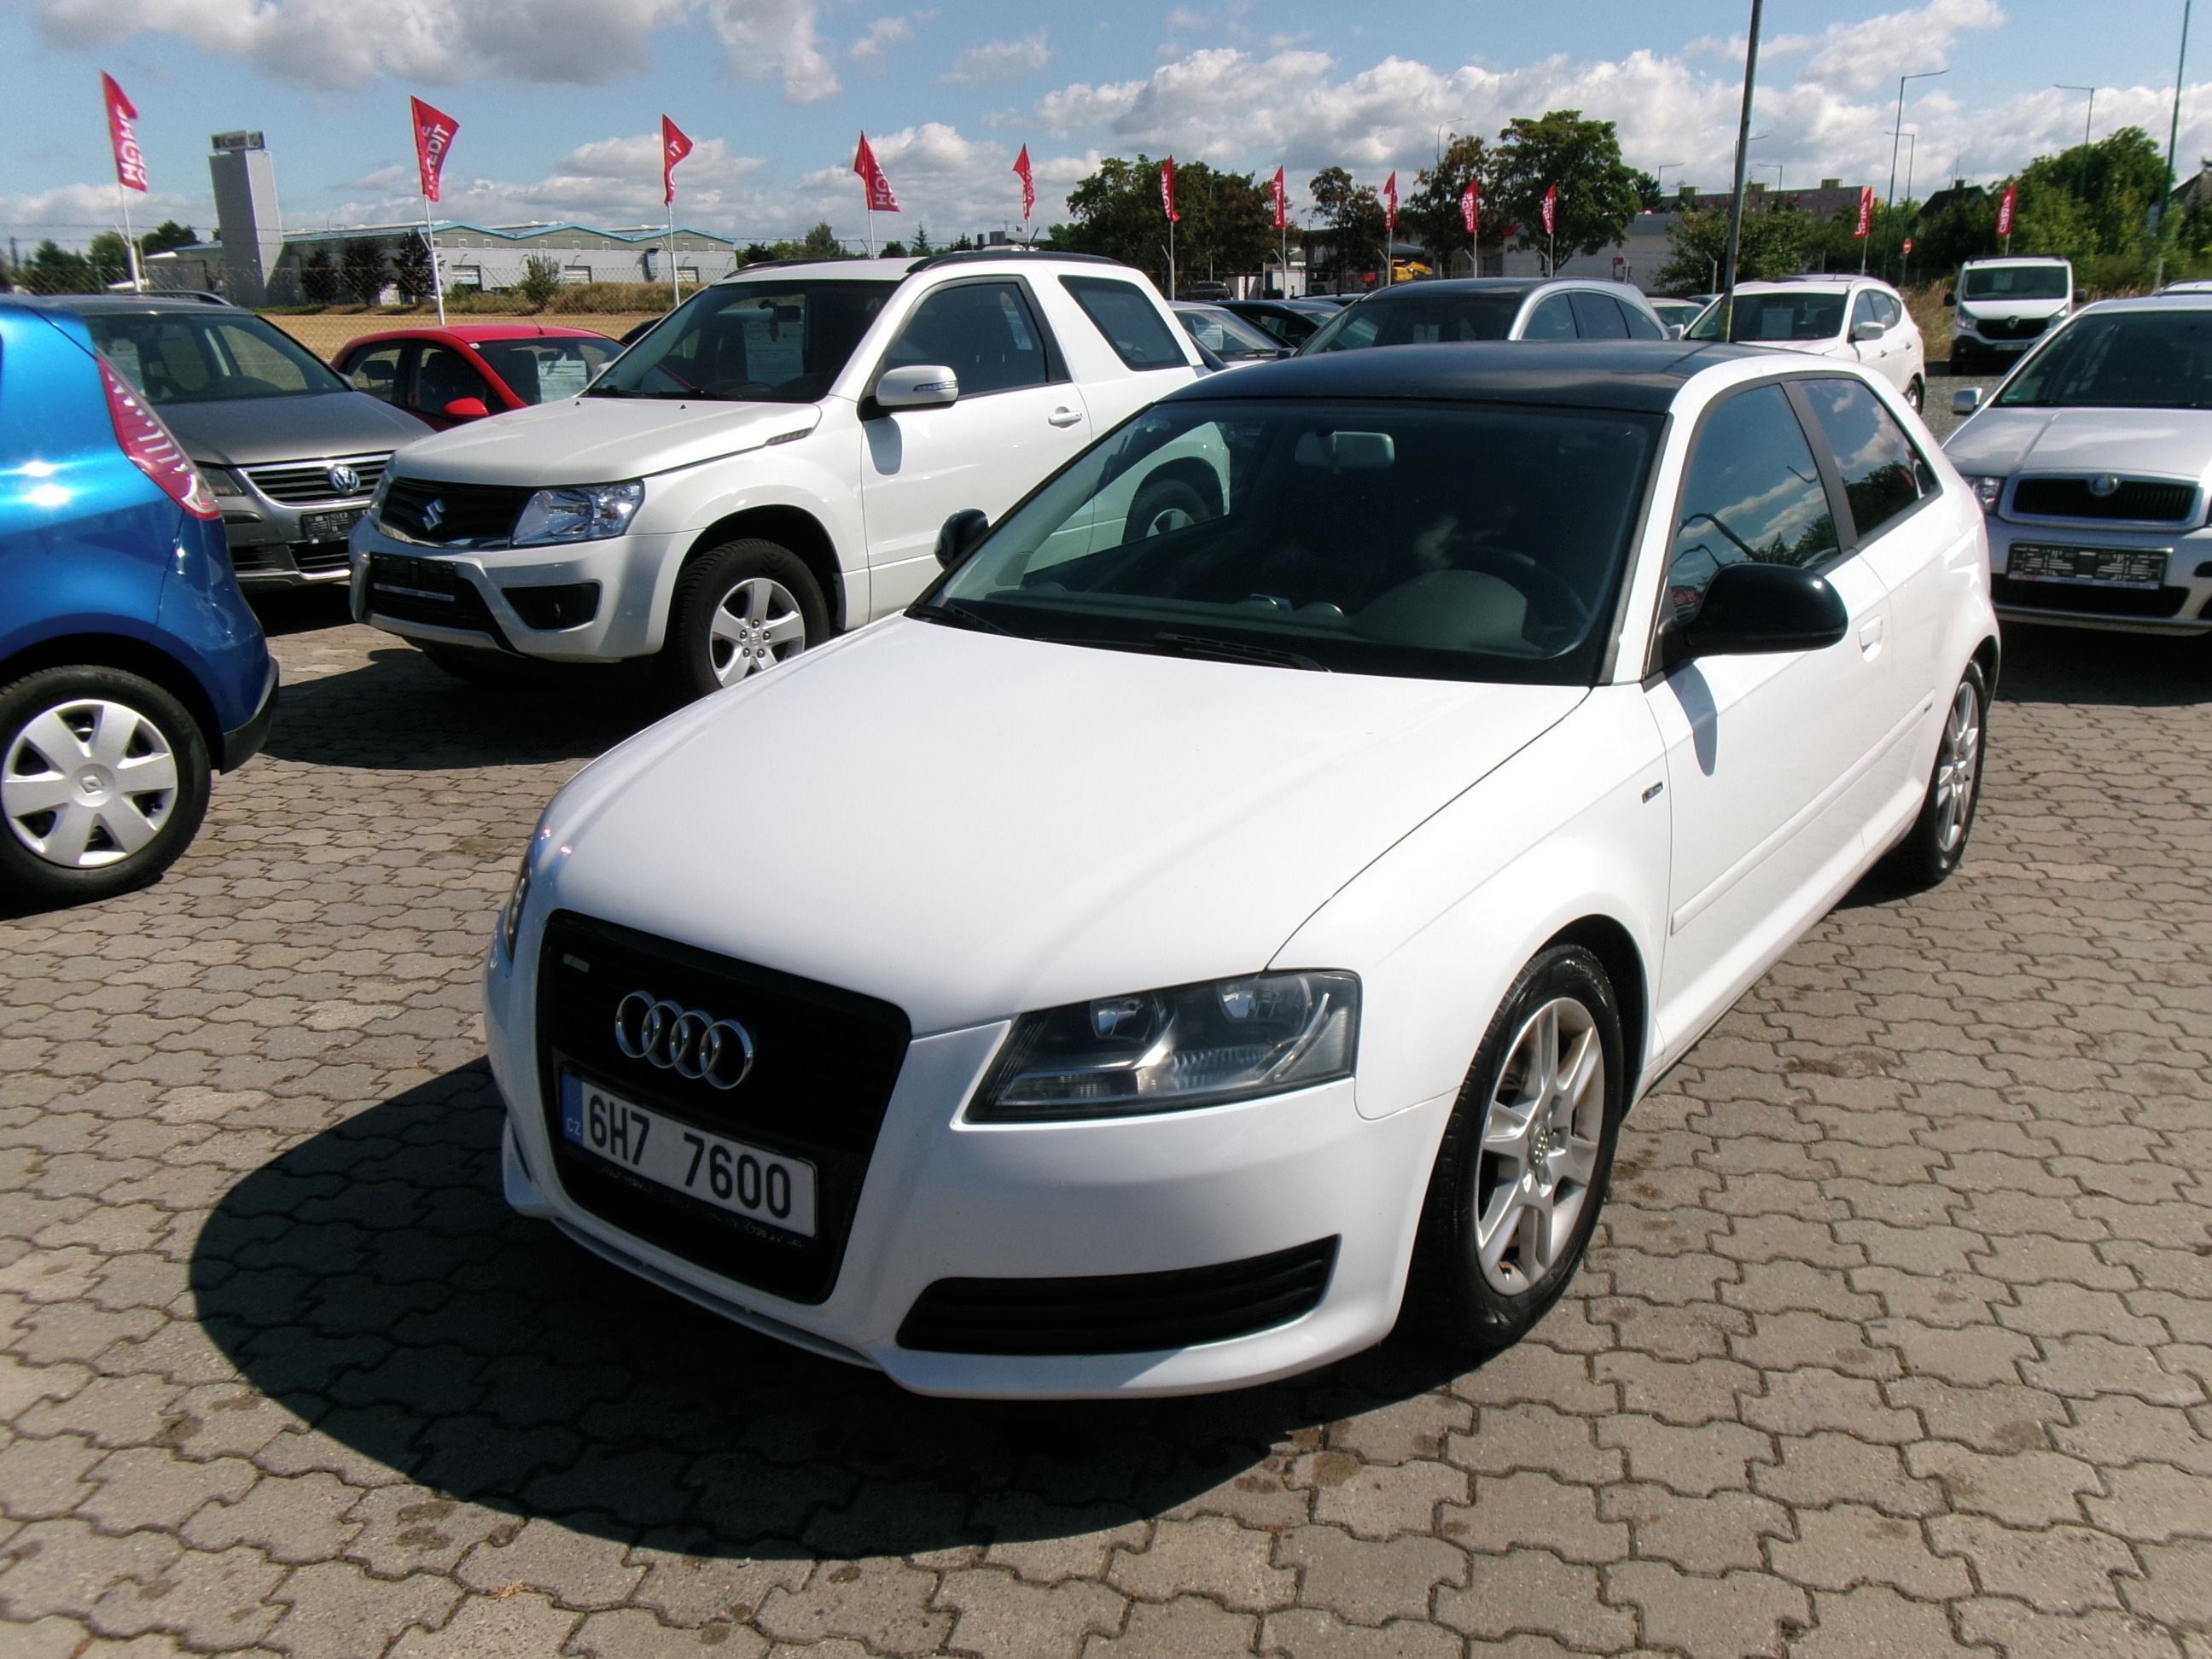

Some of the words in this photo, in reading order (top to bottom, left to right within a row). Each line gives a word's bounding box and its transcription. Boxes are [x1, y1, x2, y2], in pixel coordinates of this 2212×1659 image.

[566, 1117, 582, 1137] CZ
[589, 1094, 650, 1166] 6H7
[684, 1132, 791, 1220] 7600
